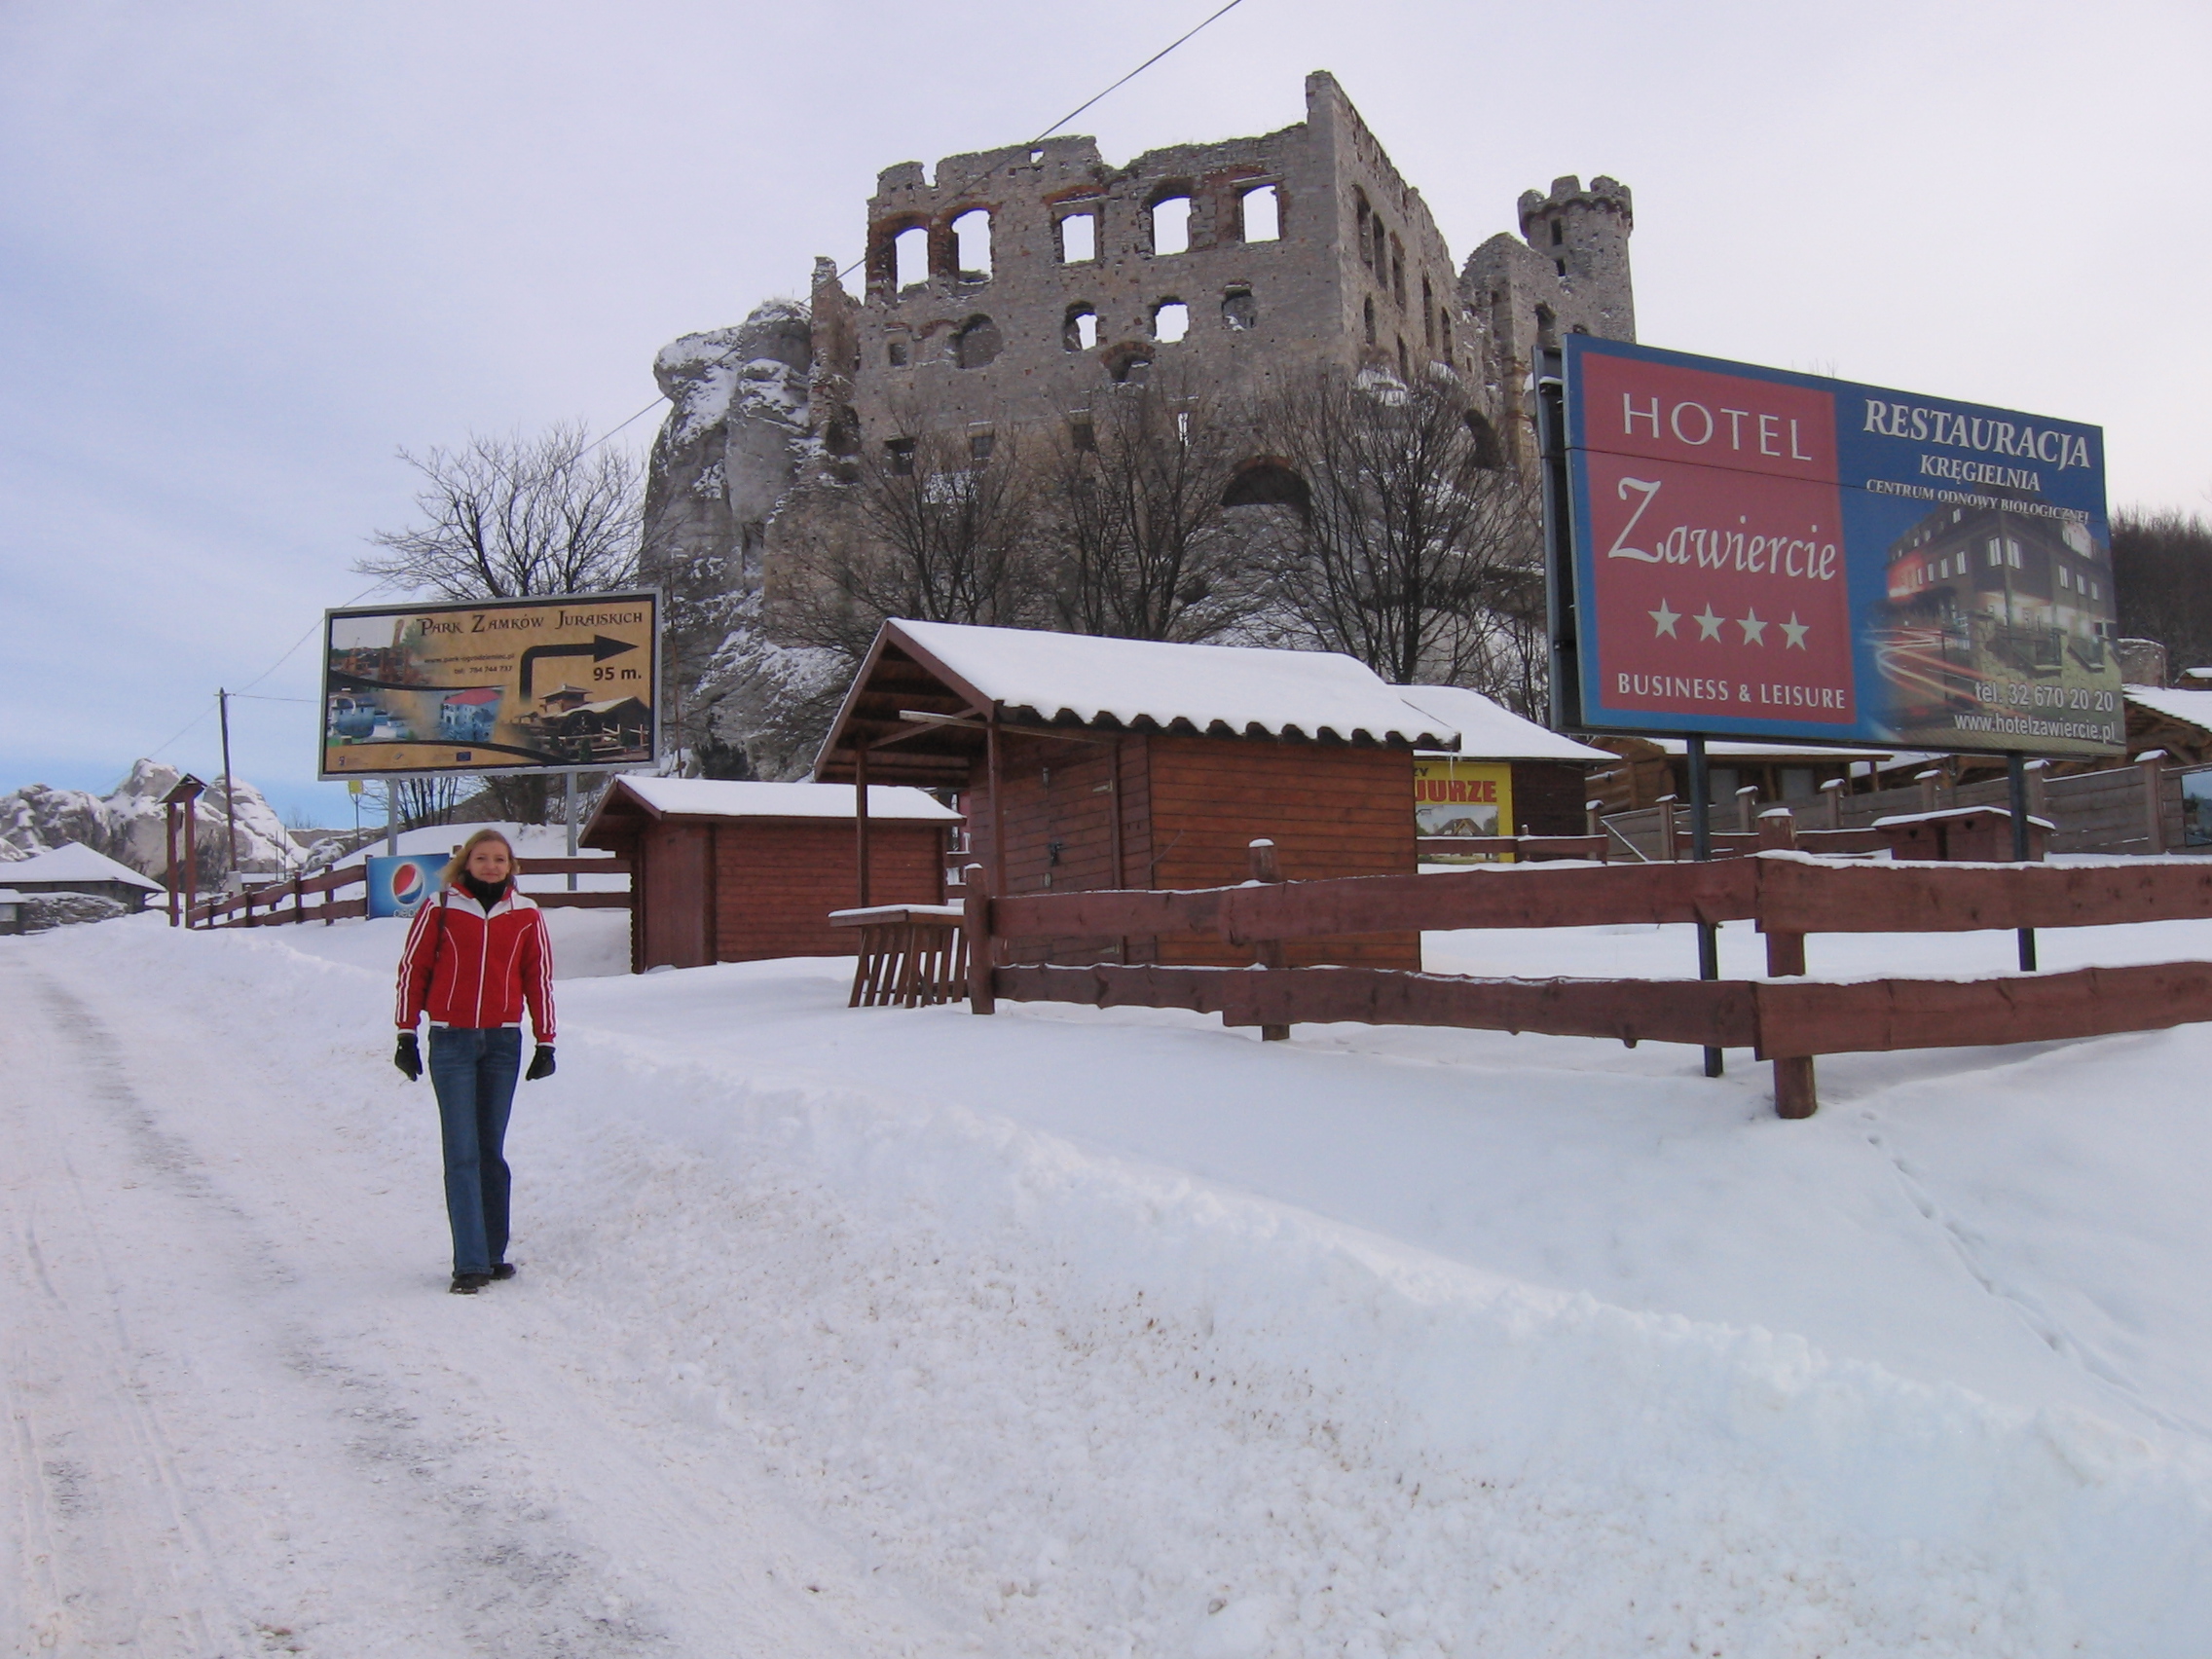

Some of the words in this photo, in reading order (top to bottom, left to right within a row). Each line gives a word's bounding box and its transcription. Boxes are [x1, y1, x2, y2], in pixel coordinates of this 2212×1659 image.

[1621, 392, 1812, 461] HOTEL
[1862, 398, 2090, 470] RESTAURACJA
[1920, 454, 2042, 492] KRĘGIELNIA
[1865, 479, 1934, 501] CENTRUM
[1936, 488, 1999, 510] ODNOWY
[2000, 497, 2089, 525] BIOLOGICZNEJ
[1607, 476, 1836, 582] Zawiercie
[417, 617, 463, 636] PARK
[471, 613, 544, 634] ZAMKÓW
[554, 609, 644, 630] JURAJSKICH
[593, 667, 614, 682] 95
[620, 669, 642, 681] m.
[1618, 672, 1729, 703] BUSINESS
[1739, 683, 1751, 703] &
[1760, 683, 1847, 710] LEISURE
[1974, 682, 2004, 704] tel.
[2008, 684, 2030, 705] 32
[2034, 686, 2064, 708] 670
[2071, 689, 2090, 710] 20
[2095, 690, 2115, 713] 20
[1954, 712, 2116, 744] www.hotelzawiercie.pl
[1415, 780, 1496, 802] JURZE
